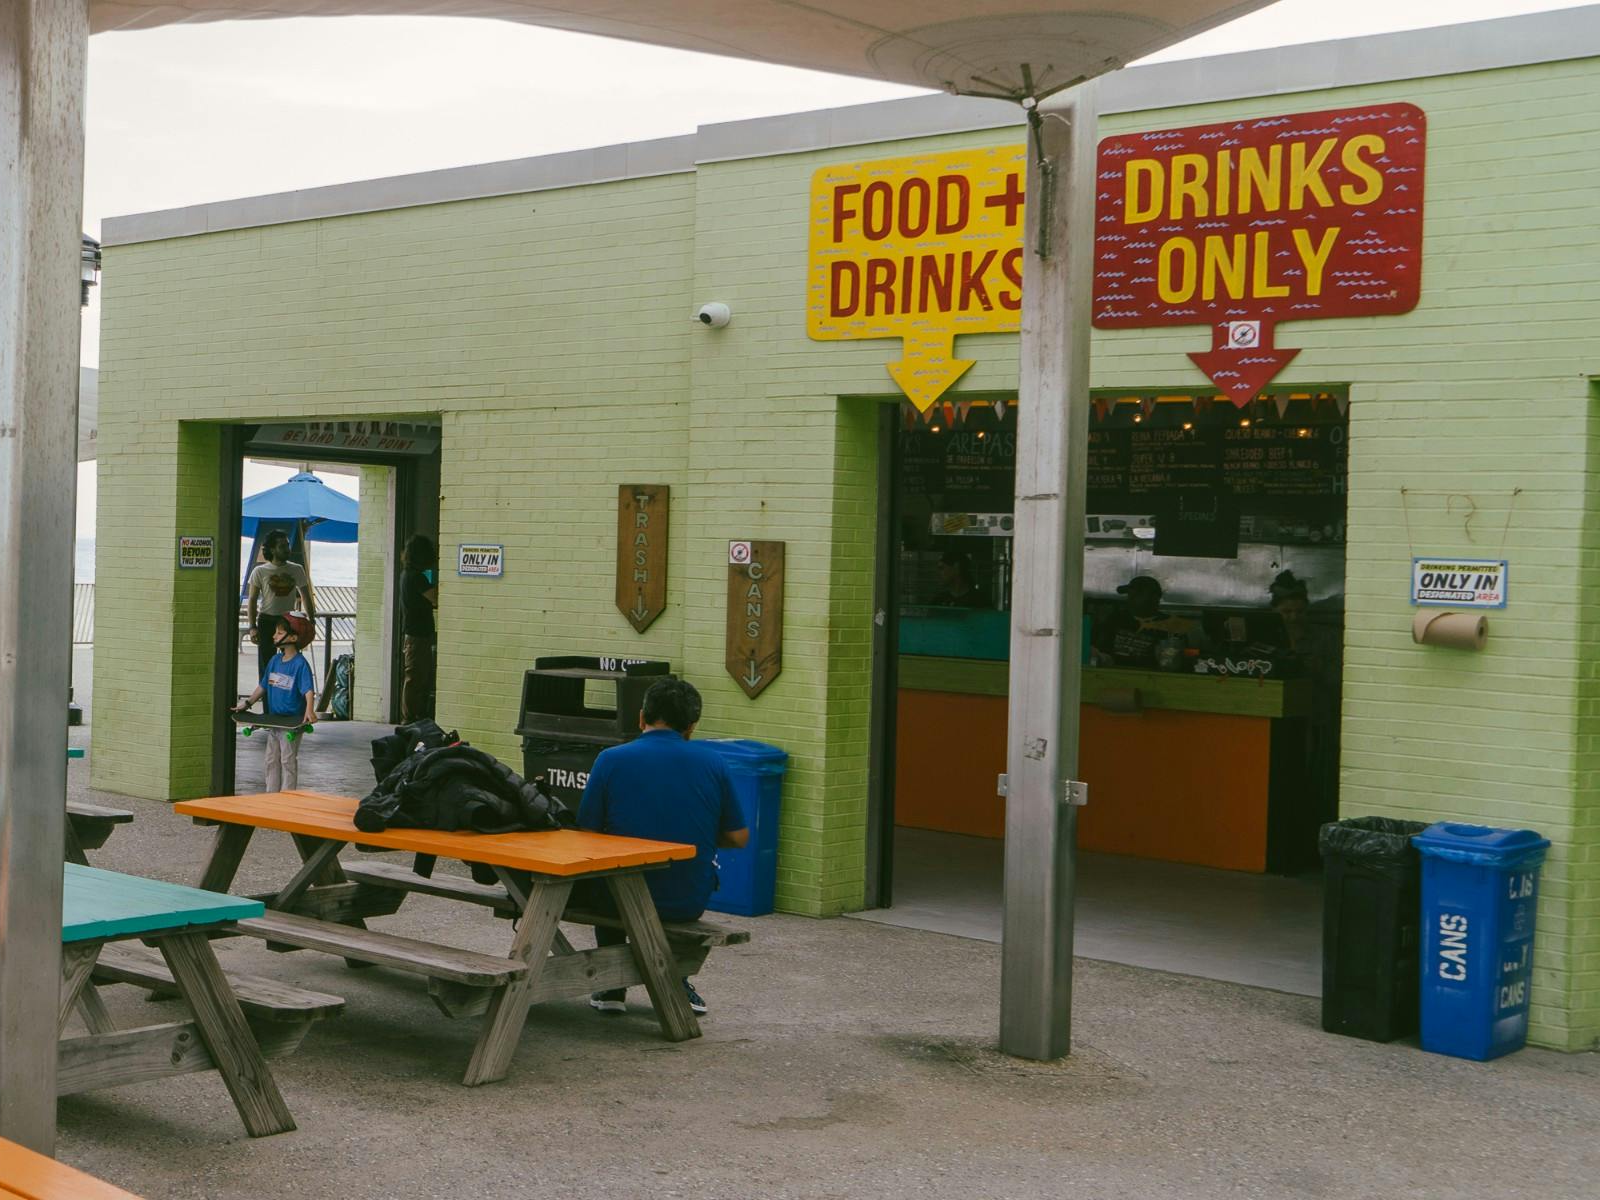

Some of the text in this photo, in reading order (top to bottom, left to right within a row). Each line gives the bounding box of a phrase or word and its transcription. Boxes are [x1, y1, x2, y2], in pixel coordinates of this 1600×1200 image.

[1124, 134, 1386, 226] DRINKS
[832, 174, 971, 244] FOOD
[1157, 226, 1341, 305] ONLY
[830, 247, 1024, 319] DRINKS
[283, 430, 416, 451] BEYOND THIS POINT
[946, 432, 1014, 457] AREPAS
[633, 495, 649, 583] TRASH
[182, 547, 211, 557] BEYOND
[462, 554, 499, 566] ONLY IN
[1457, 564, 1498, 573] PERMITTED
[1420, 573, 1499, 591] ONLY IN
[745, 562, 763, 638] CANS
[1419, 590, 1500, 601] DESIGNATED AREA
[599, 656, 616, 671] NO
[547, 767, 590, 790] TRAS
[1439, 913, 1468, 982] CANS
[1500, 981, 1525, 1009] CANS
